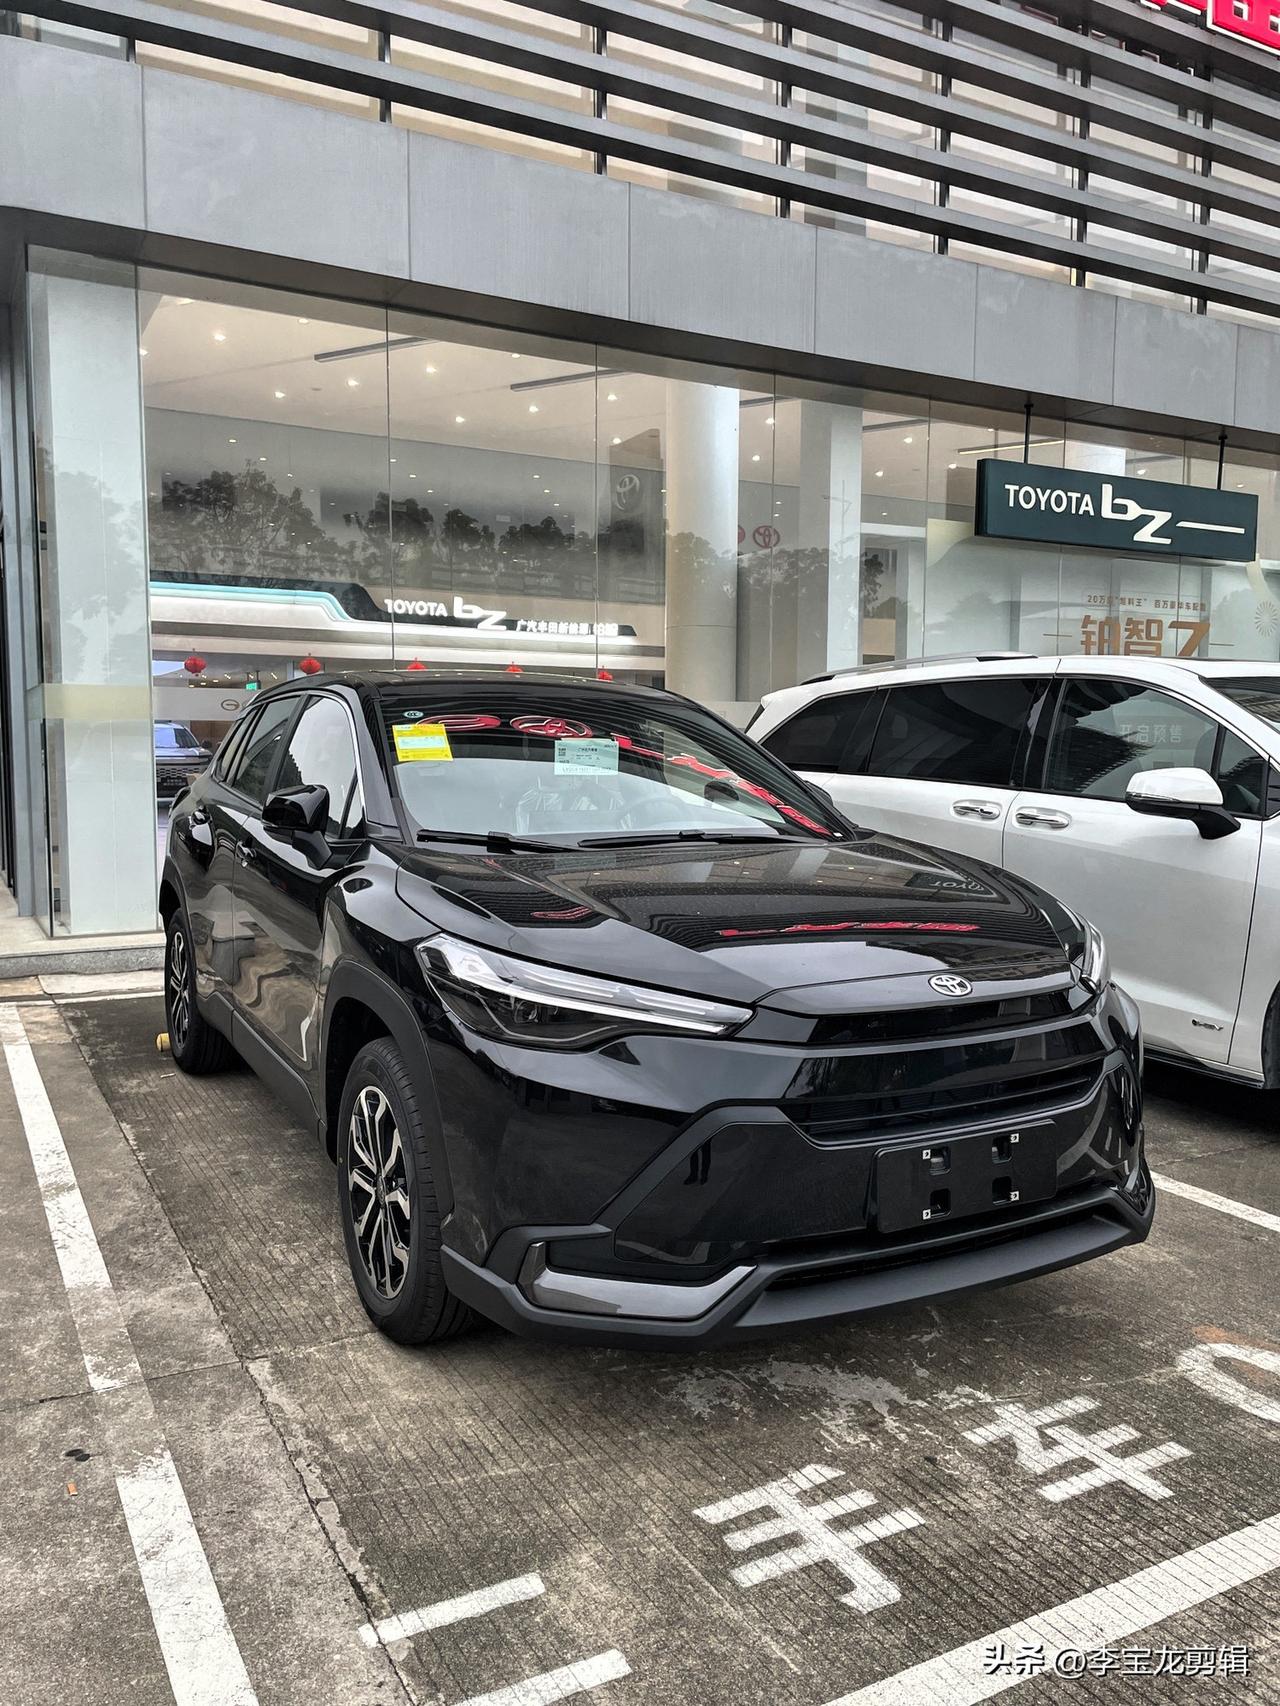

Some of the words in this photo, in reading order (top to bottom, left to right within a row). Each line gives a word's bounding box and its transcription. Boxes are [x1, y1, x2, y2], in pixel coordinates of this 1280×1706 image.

[1004, 484, 1094, 516] TOYOTA
[1101, 483, 1172, 545] bz
[384, 599, 448, 617] TOYOTA
[453, 596, 507, 631] bz
